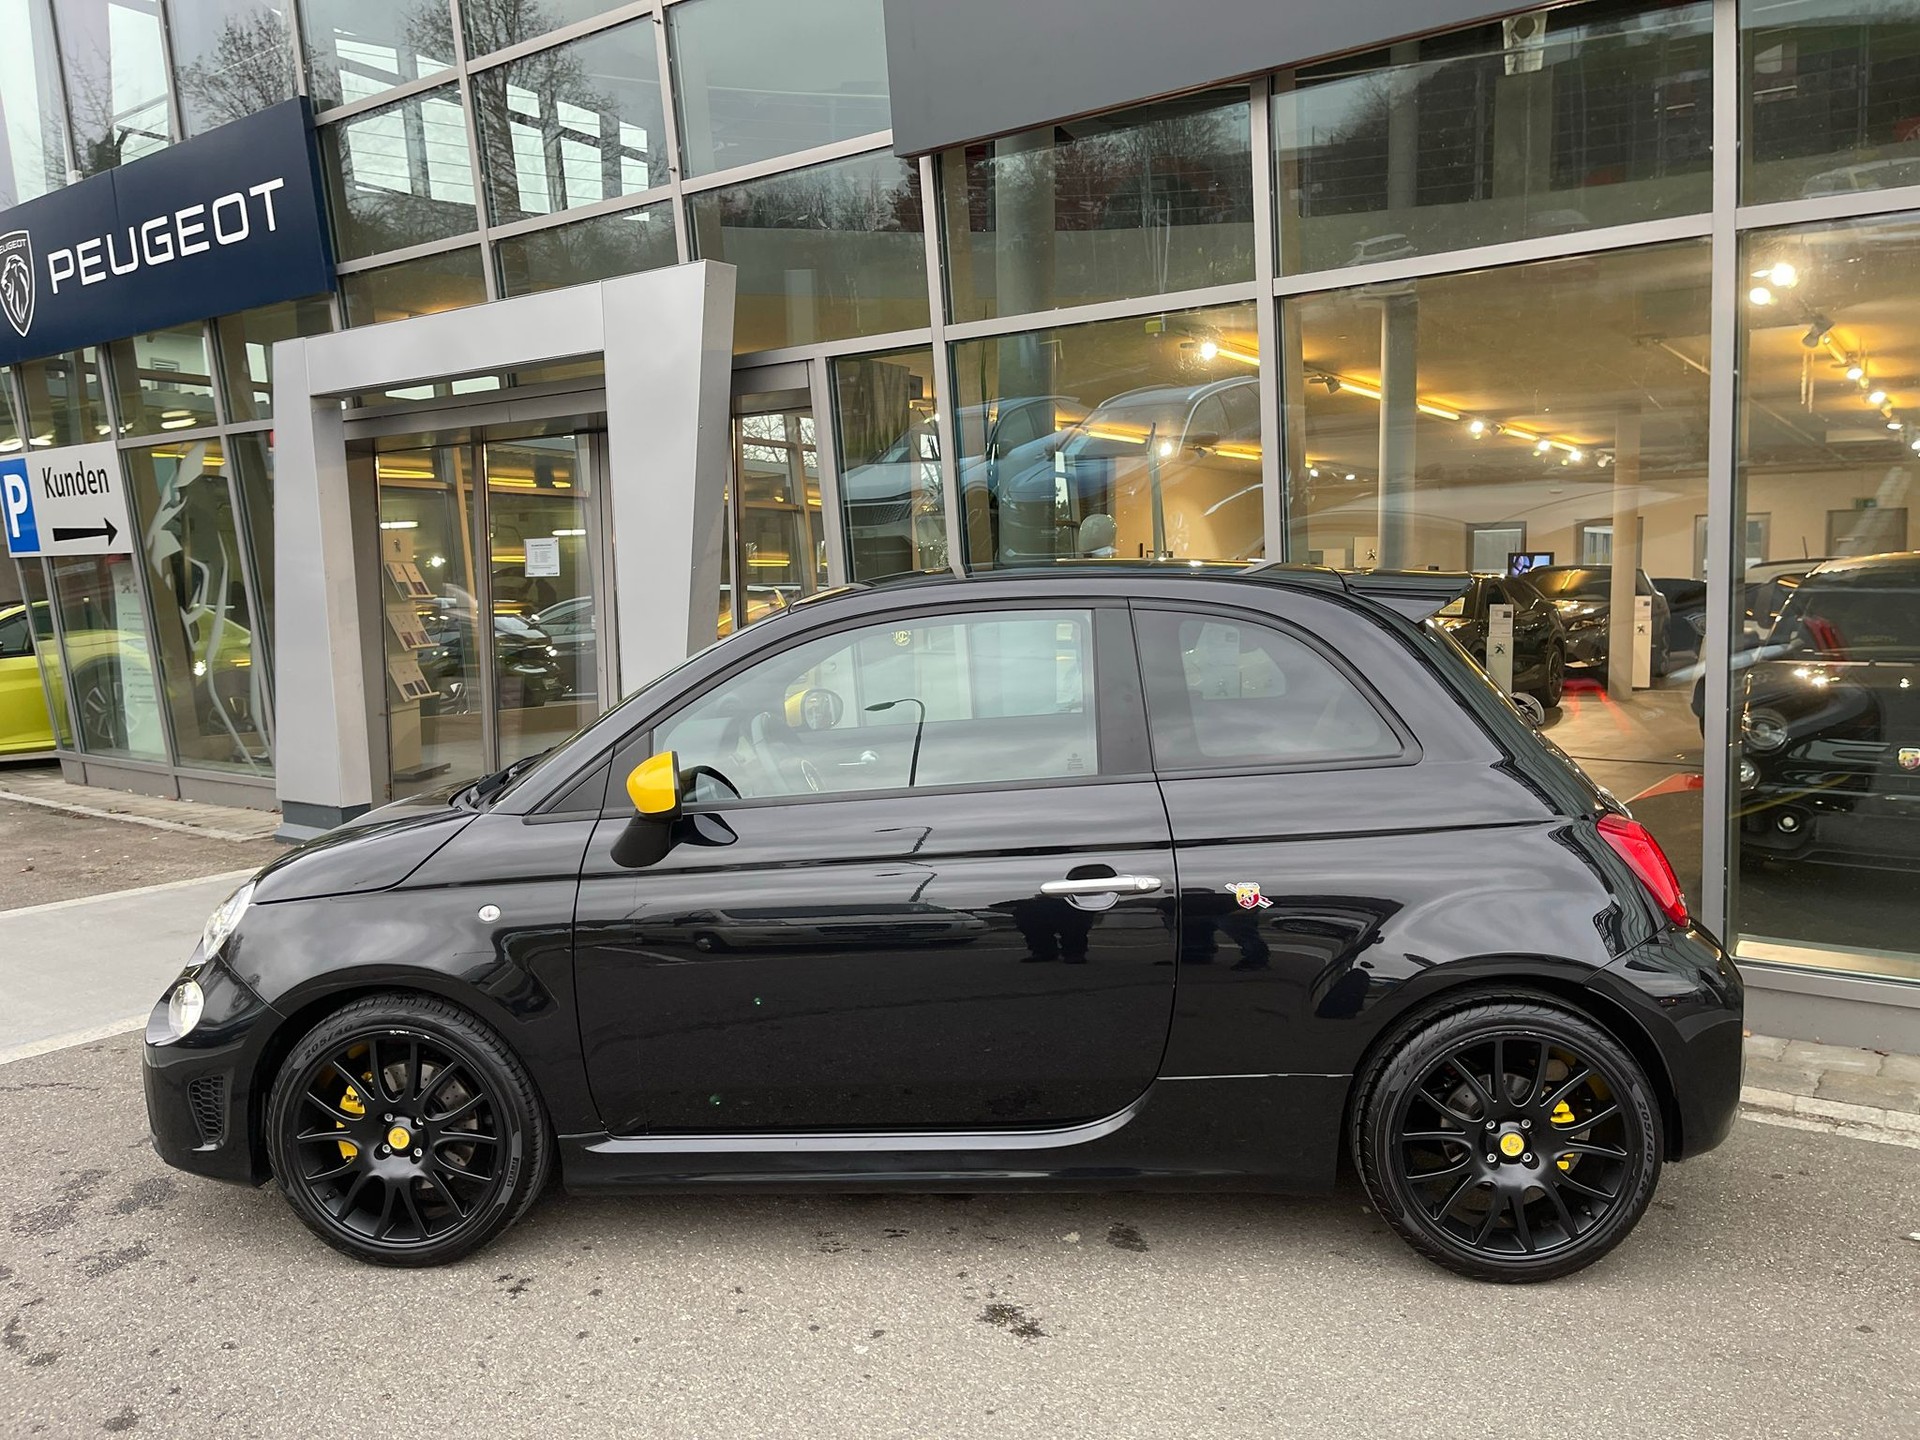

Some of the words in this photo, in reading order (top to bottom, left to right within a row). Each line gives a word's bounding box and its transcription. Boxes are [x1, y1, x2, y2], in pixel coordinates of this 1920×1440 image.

[0, 238, 27, 255] EUGEOT
[48, 177, 285, 294] PEUGEOT
[42, 460, 110, 499] Kunden
[3, 473, 28, 538] P
[304, 1024, 353, 1061] 205/40
[1637, 1100, 1654, 1164] 205/40
